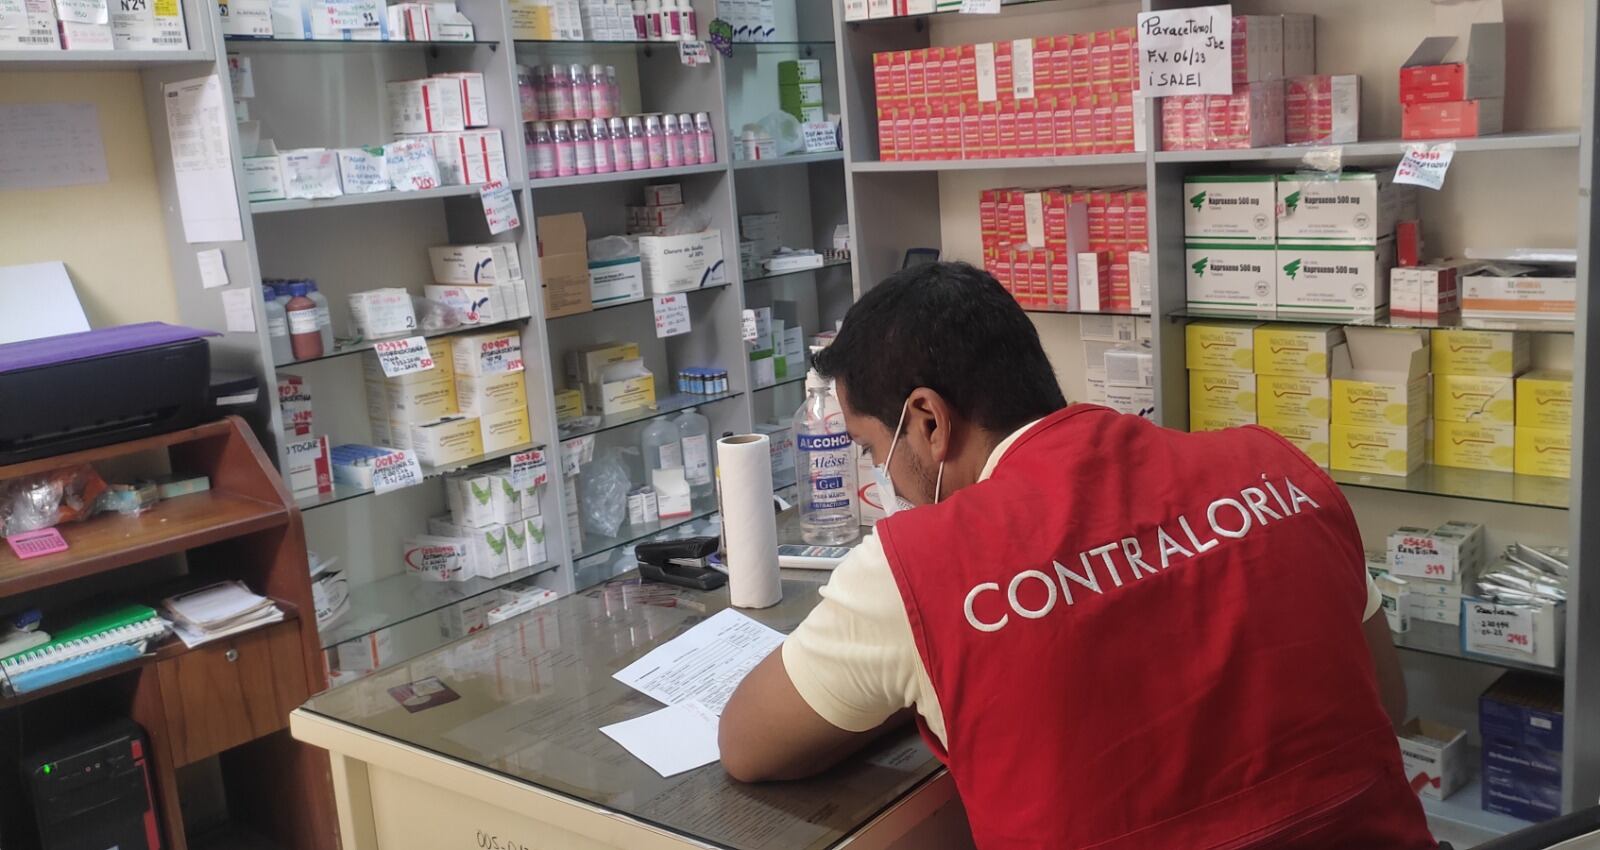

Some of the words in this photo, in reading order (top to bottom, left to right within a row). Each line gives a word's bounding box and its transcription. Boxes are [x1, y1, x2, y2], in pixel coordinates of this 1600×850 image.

[1209, 197, 1237, 205] Naproxeno
[1239, 196, 1249, 204] 500
[1304, 196, 1336, 204] Naproxeno
[1337, 195, 1349, 203] 500
[1210, 264, 1239, 272] Naproxeno
[1240, 264, 1250, 272] 500
[1252, 265, 1261, 273] mg
[1304, 265, 1335, 273] Naproxeno
[1336, 265, 1347, 273] 500
[800, 434, 850, 449] ALCOHOL
[819, 478, 841, 490] Gel
[963, 473, 1320, 633] CONTRALORÍA
